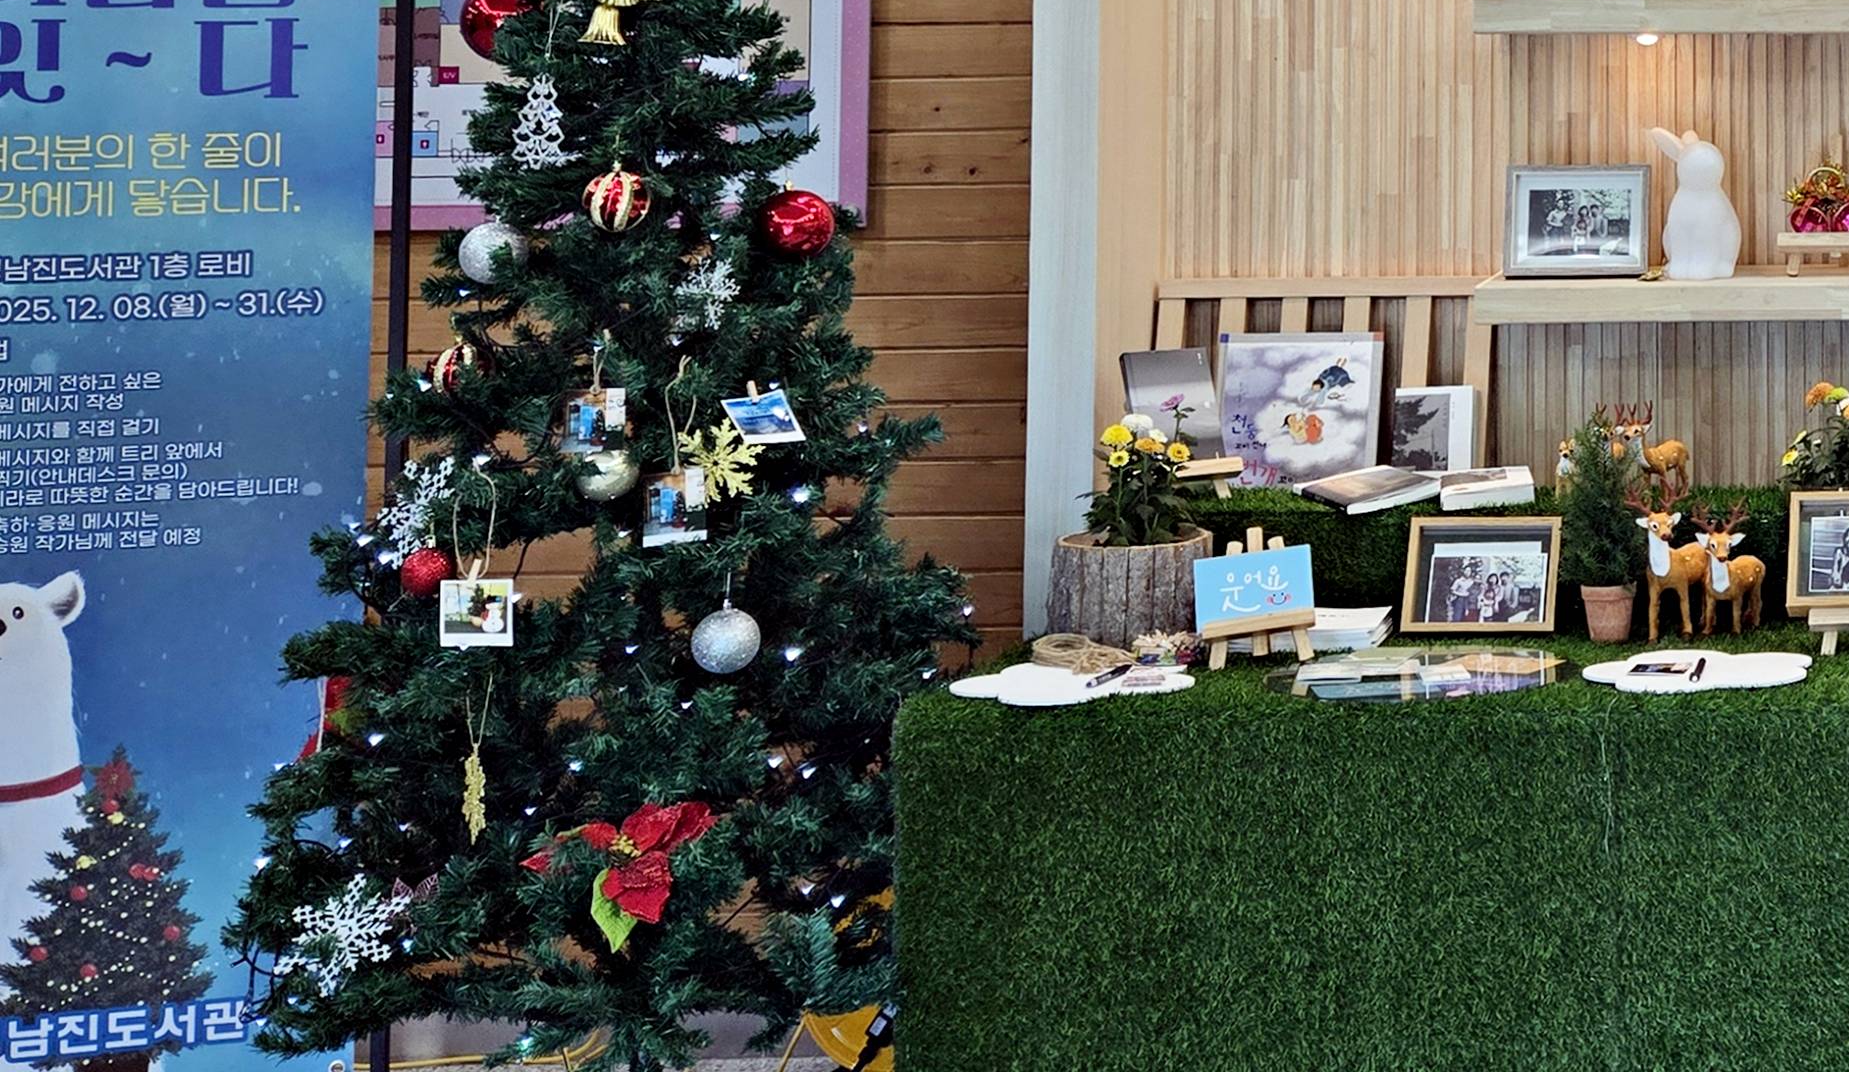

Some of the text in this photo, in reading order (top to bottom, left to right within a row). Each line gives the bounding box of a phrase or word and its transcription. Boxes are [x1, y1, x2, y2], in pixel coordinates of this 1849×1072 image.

[194, 18, 308, 98] 다
[0, 132, 281, 171] 러분의 한 줄이
[129, 177, 301, 217] 닿습니다.
[150, 253, 188, 278] 1층
[198, 252, 252, 277] 로비
[67, 297, 104, 321] 12.
[113, 293, 207, 320] 08.(월)
[238, 288, 324, 316] 31.(수)
[59, 374, 116, 391] 전하고
[123, 372, 162, 390] 싶은
[21, 395, 79, 413] 메시지
[86, 393, 124, 411] 작성
[77, 419, 115, 437] 직접
[122, 418, 160, 436] 걸기
[77, 446, 114, 464] 함께
[121, 444, 158, 462] 트리
[165, 442, 223, 461] 앞에서
[142, 462, 188, 481] 문의)
[0, 478, 299, 507] 라로 따뜻한 순간을 담아드립니다!
[82, 510, 159, 530] 메시지는
[35, 531, 113, 552] 작가님께
[119, 529, 158, 548] 전달
[163, 527, 201, 546] 예정
[8, 1001, 244, 1060] 남진도서관
